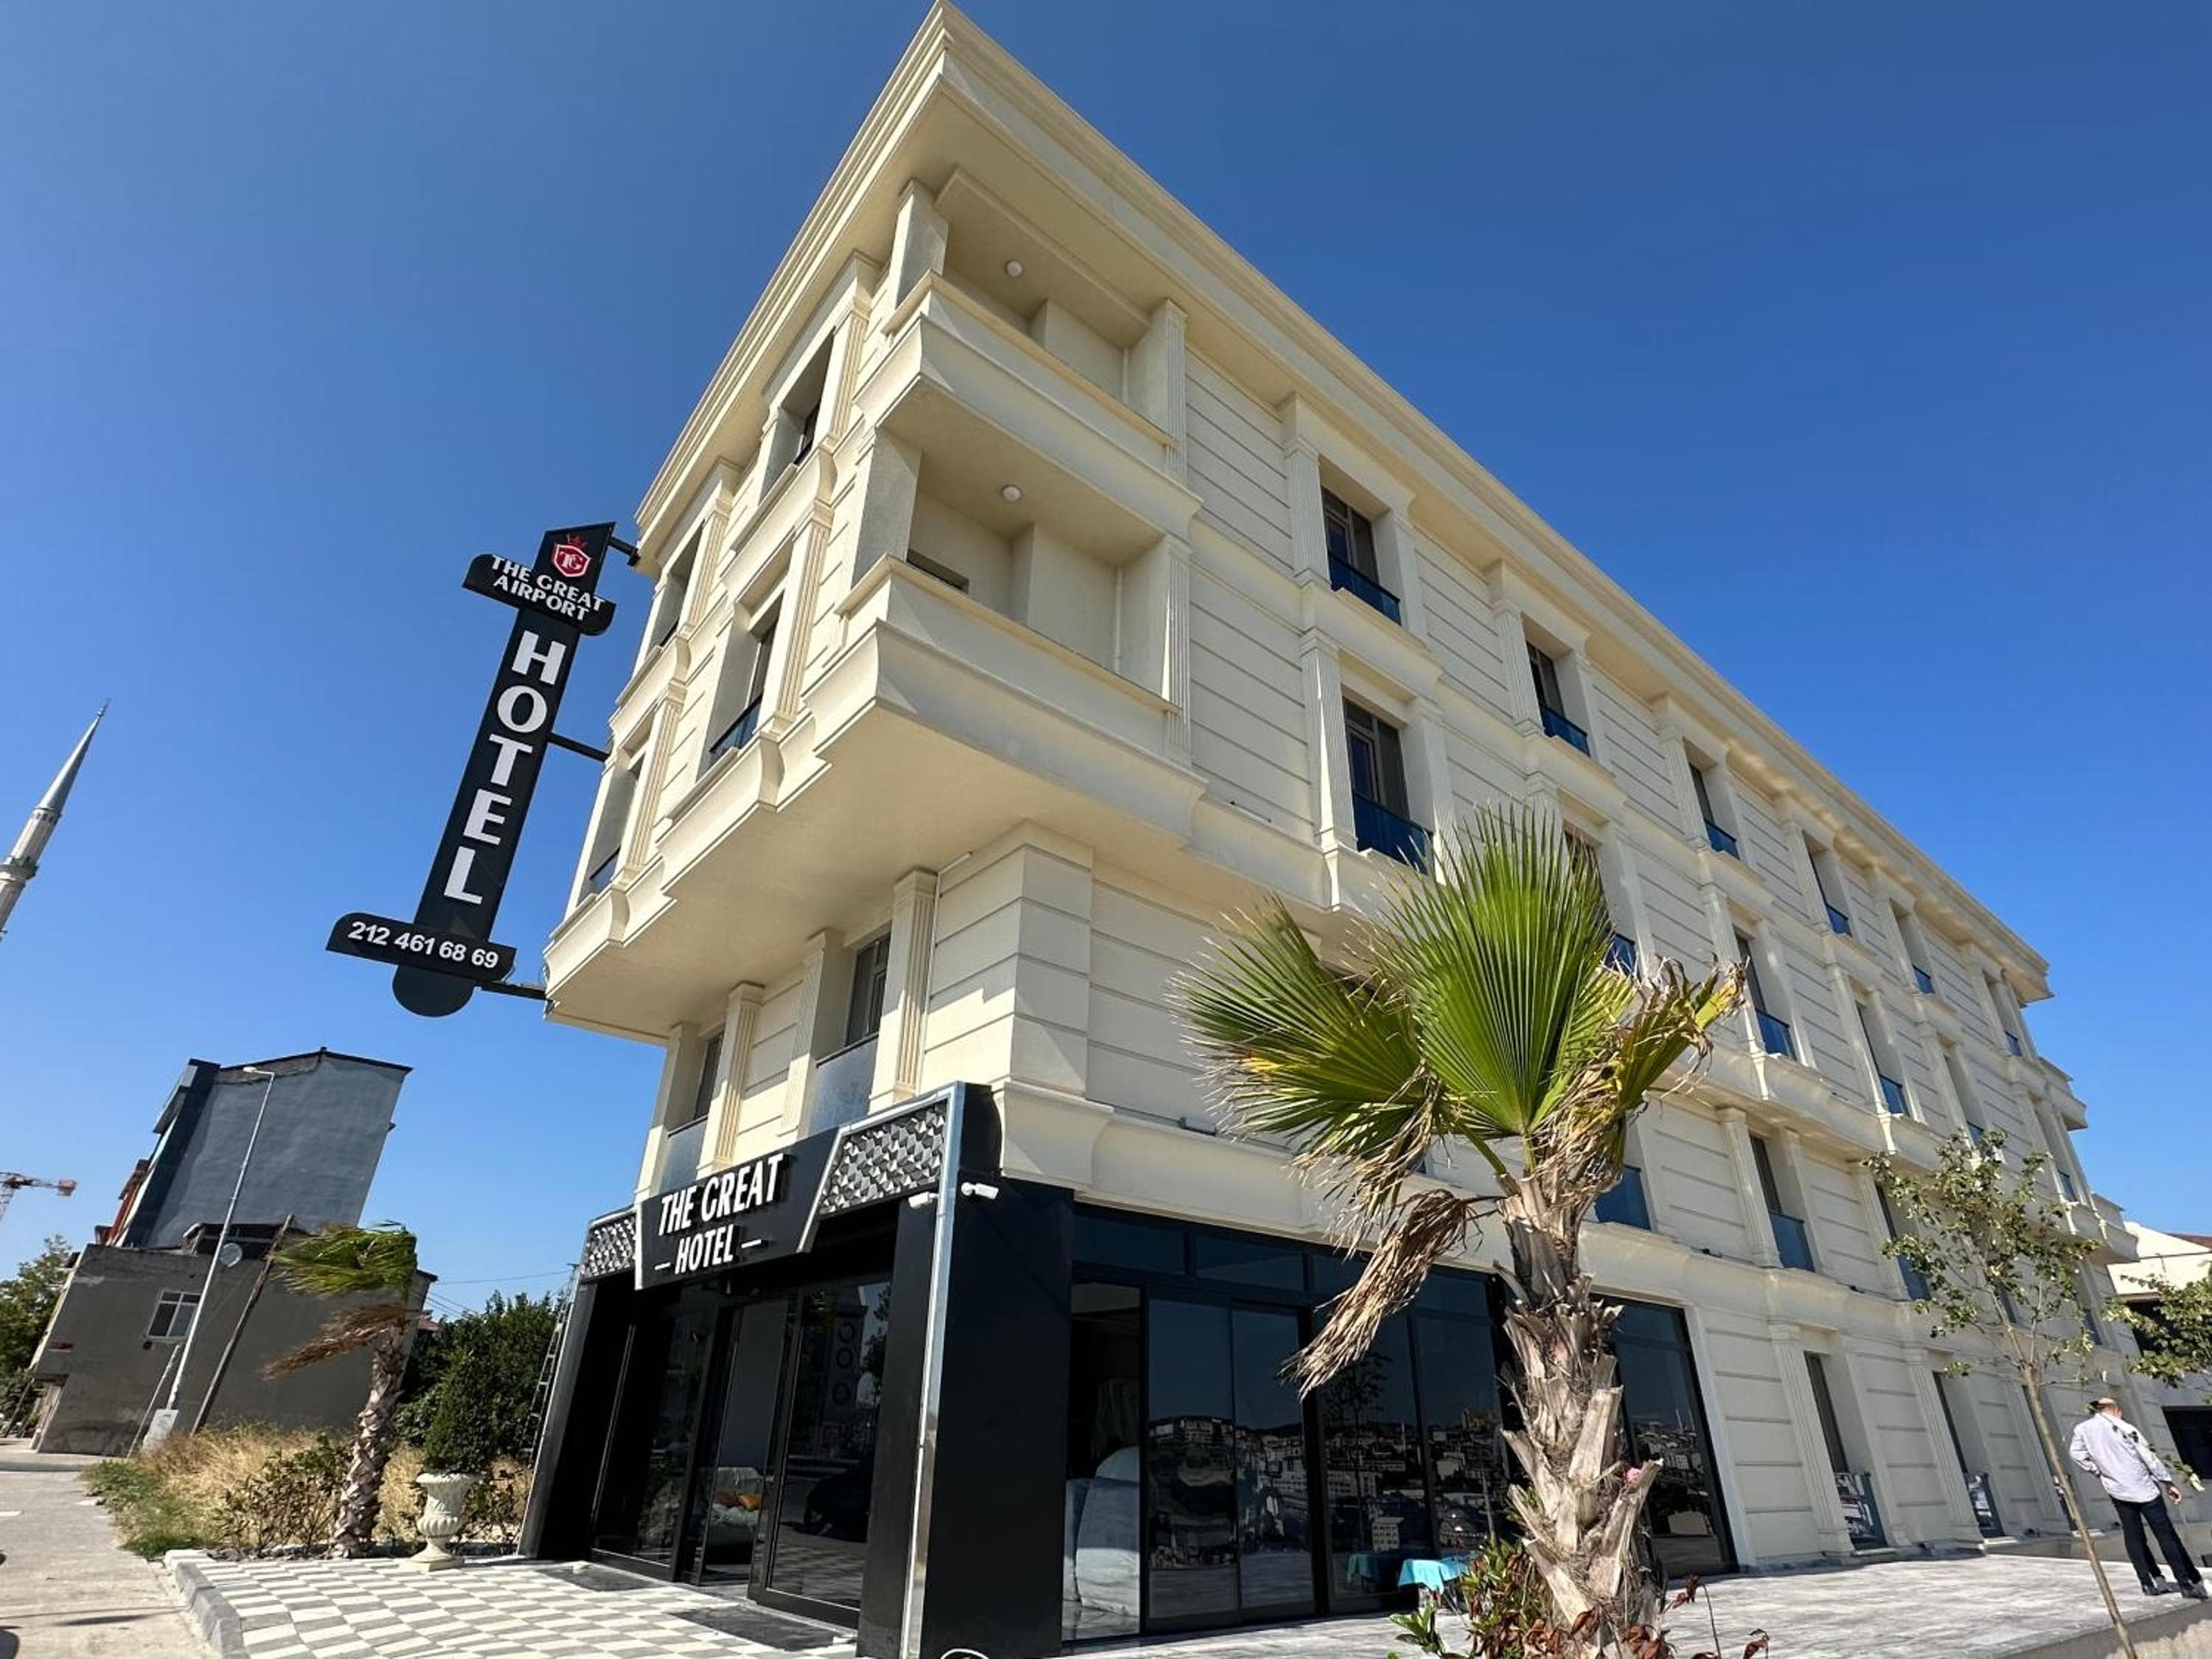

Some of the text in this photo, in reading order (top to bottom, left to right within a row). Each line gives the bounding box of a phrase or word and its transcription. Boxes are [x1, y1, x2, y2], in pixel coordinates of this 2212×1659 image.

[491, 554, 605, 612] THE GREAT
[493, 574, 590, 621] AIRPORT
[443, 629, 566, 904] HOTEL
[347, 921, 499, 969] 212 461 68 69
[658, 1185, 698, 1237] THE
[674, 1224, 734, 1275] HOTEL
